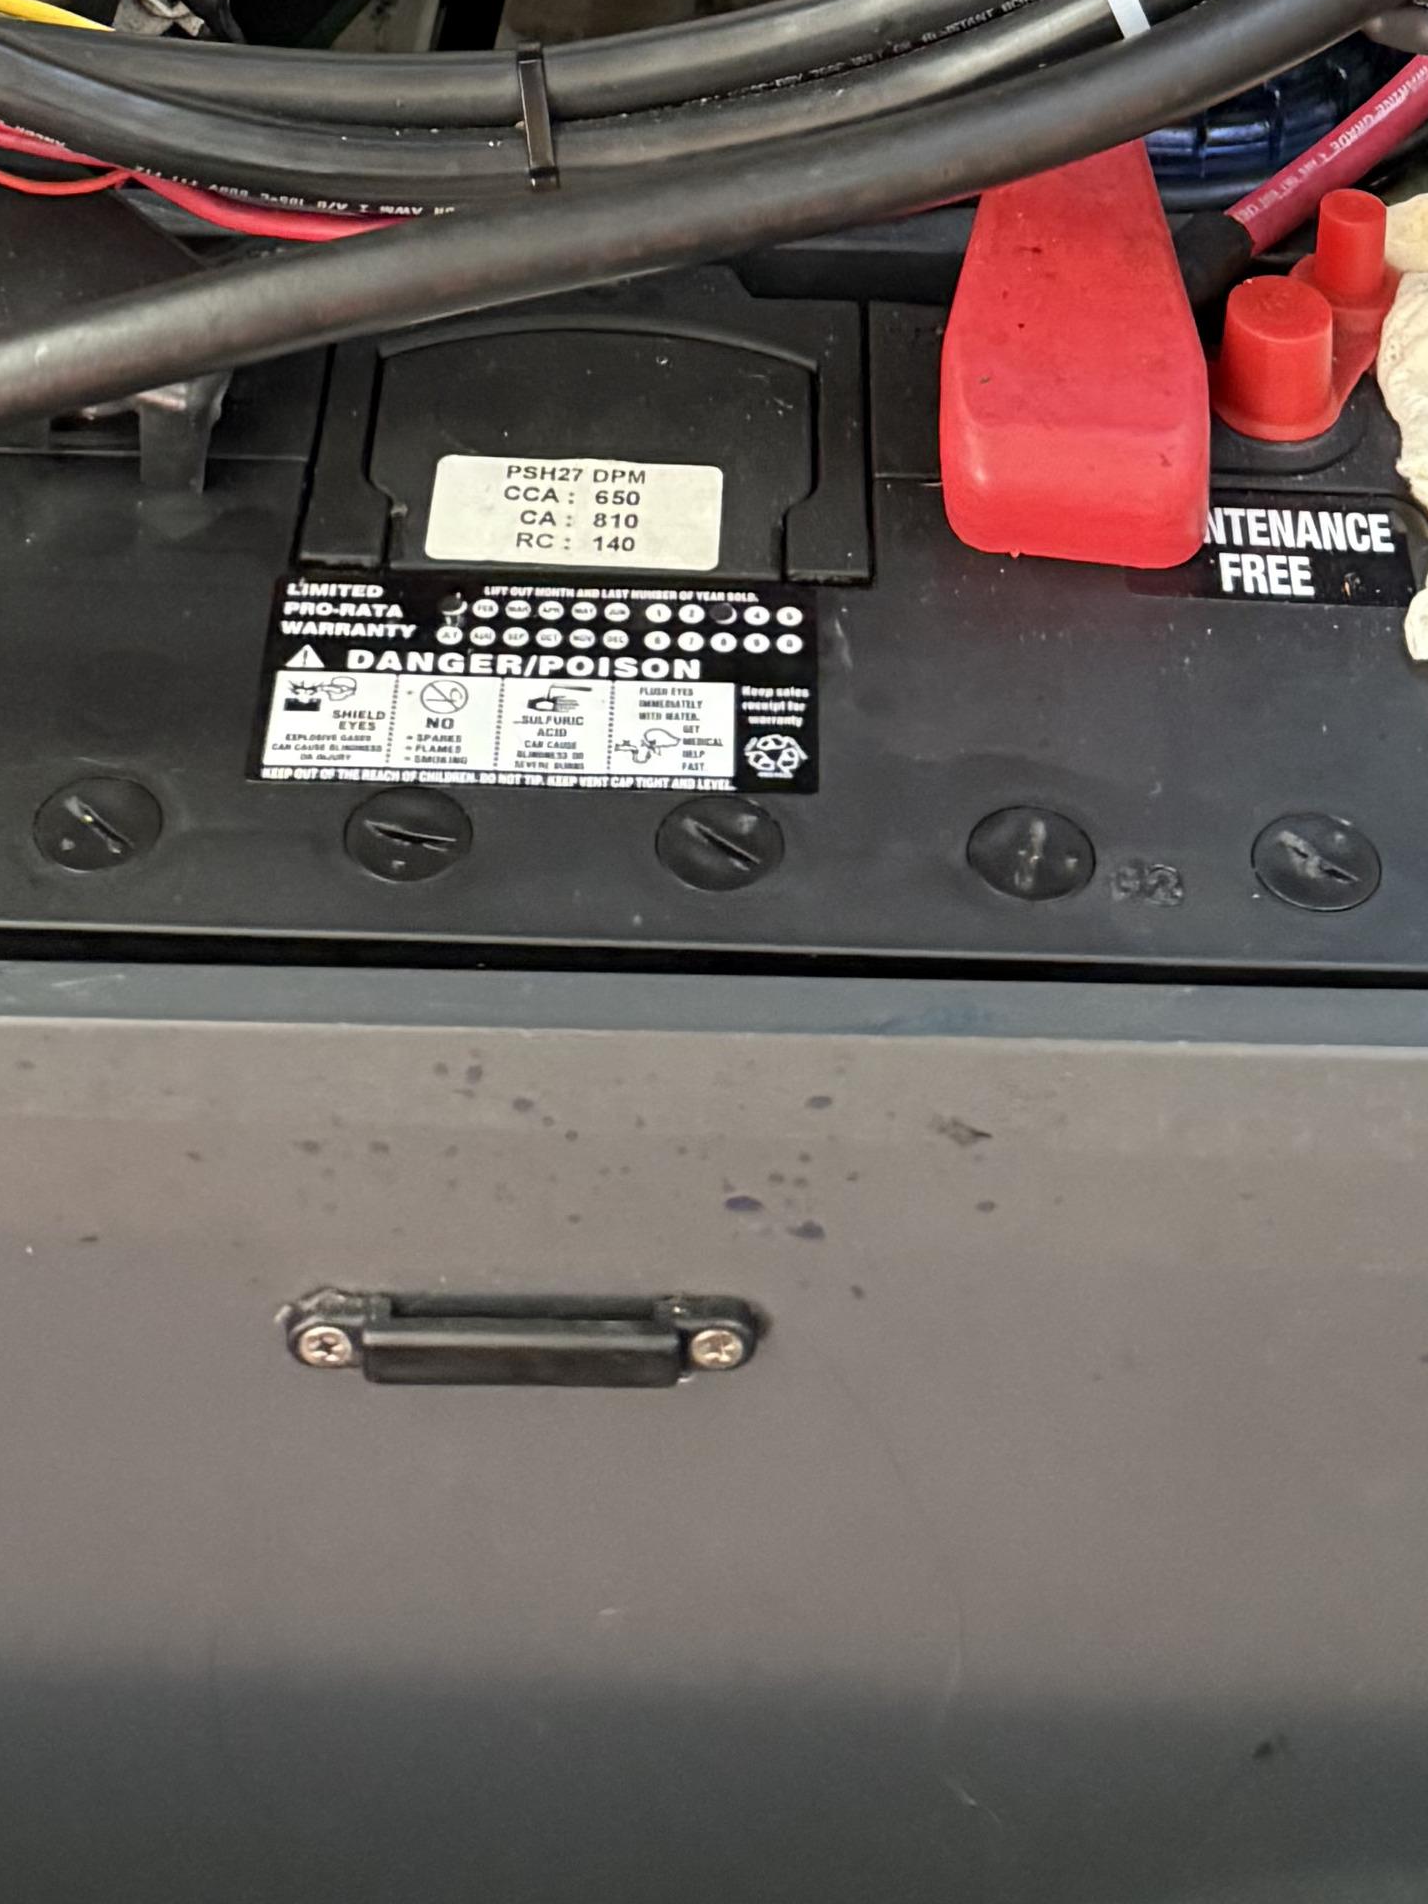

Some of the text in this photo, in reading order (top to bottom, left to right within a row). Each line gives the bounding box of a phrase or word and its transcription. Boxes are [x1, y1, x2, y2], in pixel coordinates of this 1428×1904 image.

[506, 464, 646, 485] PSH27 DPM
[503, 486, 560, 504] CCA
[594, 490, 641, 506] 650
[520, 510, 557, 527] CA
[592, 513, 639, 529] 810
[1204, 507, 1395, 553] NTENANCE
[515, 532, 555, 549] RC
[593, 536, 636, 552] 140
[1218, 552, 1315, 597] FREE
[286, 582, 385, 598] LIMITED
[484, 585, 760, 603] LIFT OUT MONTH AND LAST NUMBER OF YEAR SOLD.
[283, 601, 404, 619] PRO-RATA
[281, 620, 418, 639] WARRANTY
[347, 648, 702, 680] DANGER/POISON
[639, 687, 694, 697] FLUSH EYES
[741, 685, 810, 698] Keep sales
[639, 700, 703, 709] IMMEDIATELY
[741, 700, 806, 712] receipt for
[332, 709, 386, 721] SHIELD
[522, 715, 584, 726] SULFURIC
[639, 712, 662, 721] WITH
[338, 721, 377, 731] EYES
[426, 717, 455, 730] NO
[748, 715, 804, 728] warranty
[537, 728, 568, 738] ACID
[683, 725, 700, 734] GET
[416, 734, 462, 743] SPARKS
[524, 740, 577, 749] CAN CAUSE
[682, 737, 724, 747] MEDICAL
[272, 743, 292, 751] CAN
[294, 743, 325, 752] CAUSE
[415, 744, 462, 753] FLAMES
[414, 755, 468, 765] SMOKING
[682, 750, 705, 759] HELP
[261, 767, 293, 779] KEEP
[294, 767, 319, 780] OUT
[320, 768, 336, 780] OF
[337, 768, 360, 781] THE
[361, 769, 400, 782] REACH
[401, 770, 418, 782] OF
[479, 772, 497, 784] DO
[497, 772, 522, 785] NOT
[547, 774, 578, 787] KEEP
[579, 775, 610, 787] VENT
[610, 776, 635, 789] CAP
[635, 777, 670, 789] TIGHT
[672, 778, 696, 790] AND
